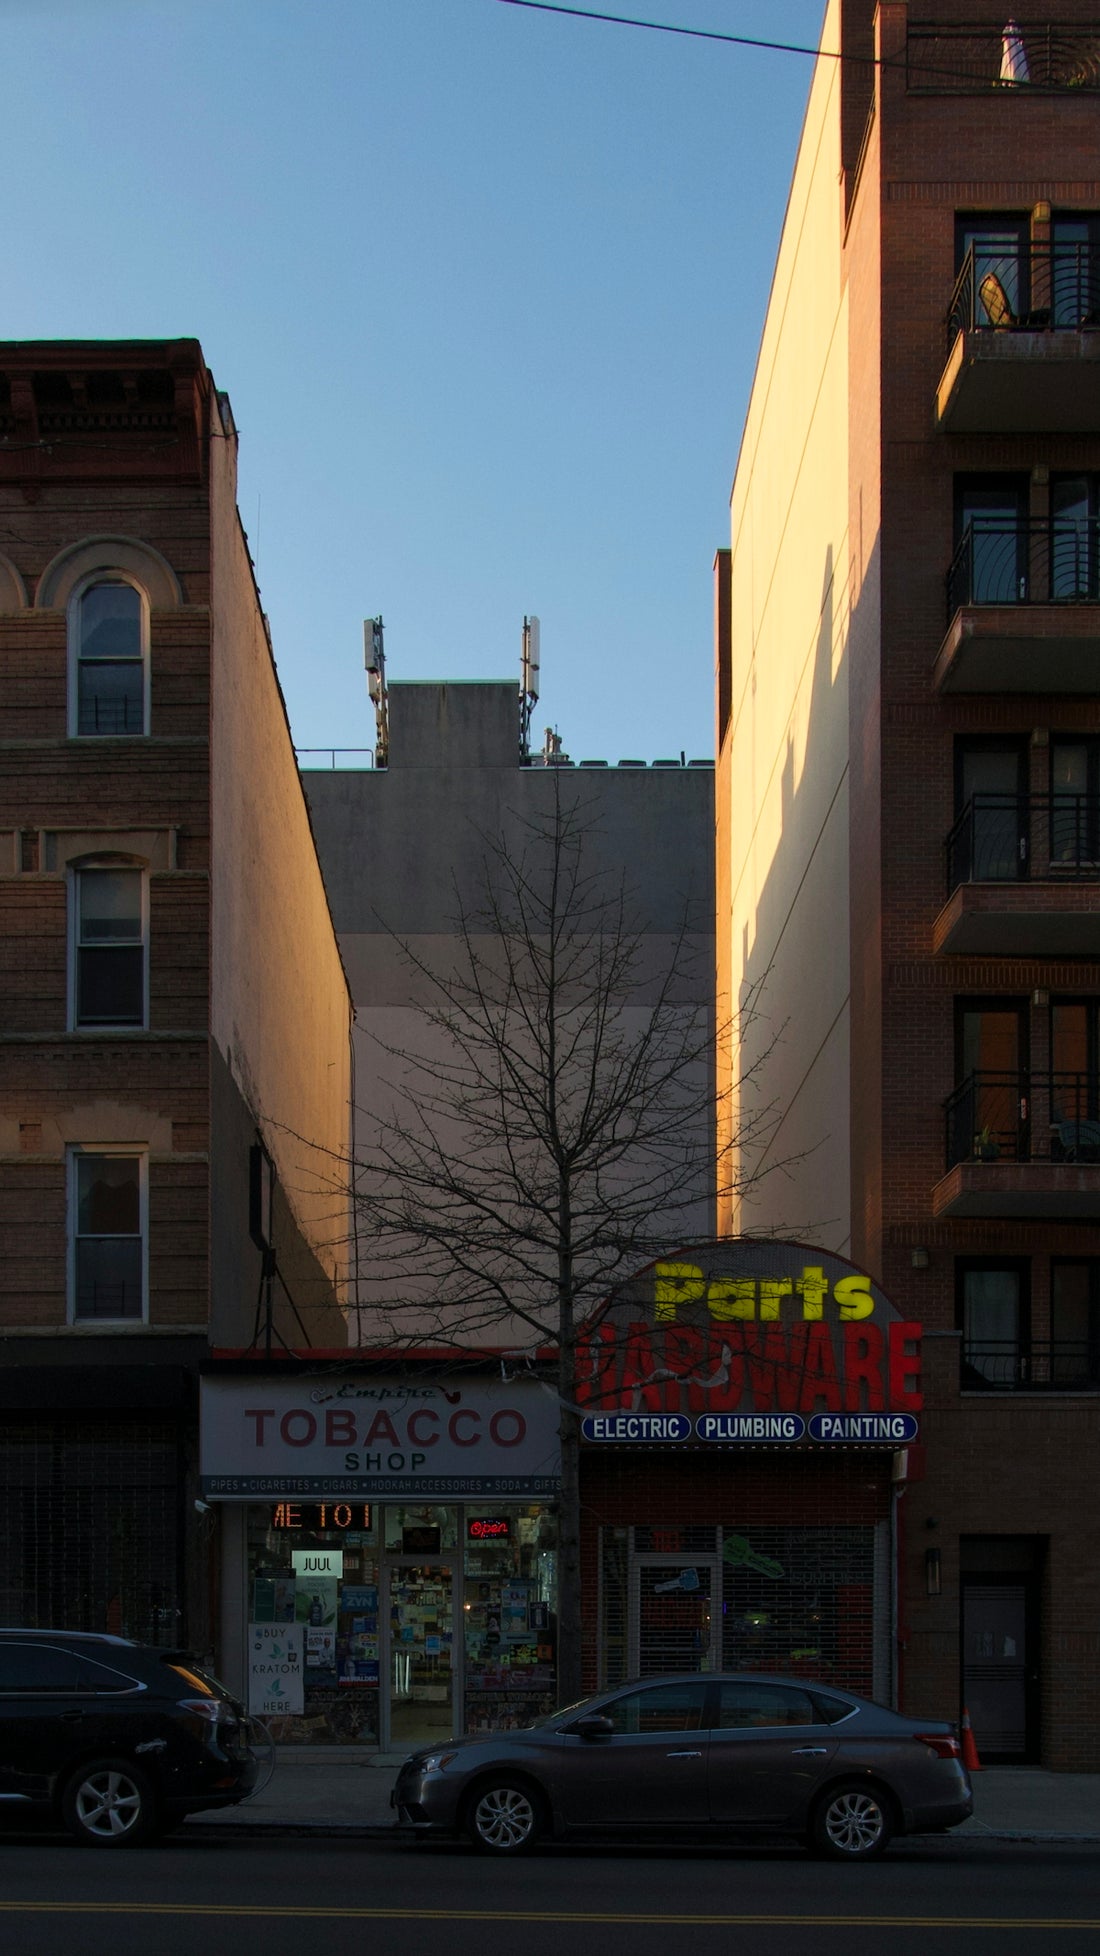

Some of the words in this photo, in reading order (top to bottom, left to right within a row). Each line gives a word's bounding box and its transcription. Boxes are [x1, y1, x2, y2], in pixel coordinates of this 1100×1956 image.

[655, 1261, 875, 1322] Parts
[574, 1320, 924, 1413] HARDWARE
[337, 1384, 437, 1403] Empire
[244, 1409, 527, 1448] TOBACCO
[593, 1417, 681, 1438] ELECTRIC
[705, 1417, 796, 1438] PLUMBING
[821, 1417, 906, 1438] PAINTING
[345, 1453, 427, 1471] SHOP
[210, 1479, 239, 1490] PIPES
[250, 1479, 310, 1490] CIGARETTES
[322, 1479, 358, 1490] CIGARS
[370, 1479, 413, 1490] HOOKAH
[414, 1479, 482, 1490] ACCESSORIES
[495, 1479, 521, 1490] SODA
[315, 1503, 352, 1527] TO
[469, 1520, 508, 1538] Open
[303, 1557, 331, 1571] JUUL
[346, 1596, 373, 1607] ZYN
[264, 1629, 286, 1638] BUY
[252, 1664, 300, 1673] KRATOM
[263, 1702, 291, 1711] HERE
